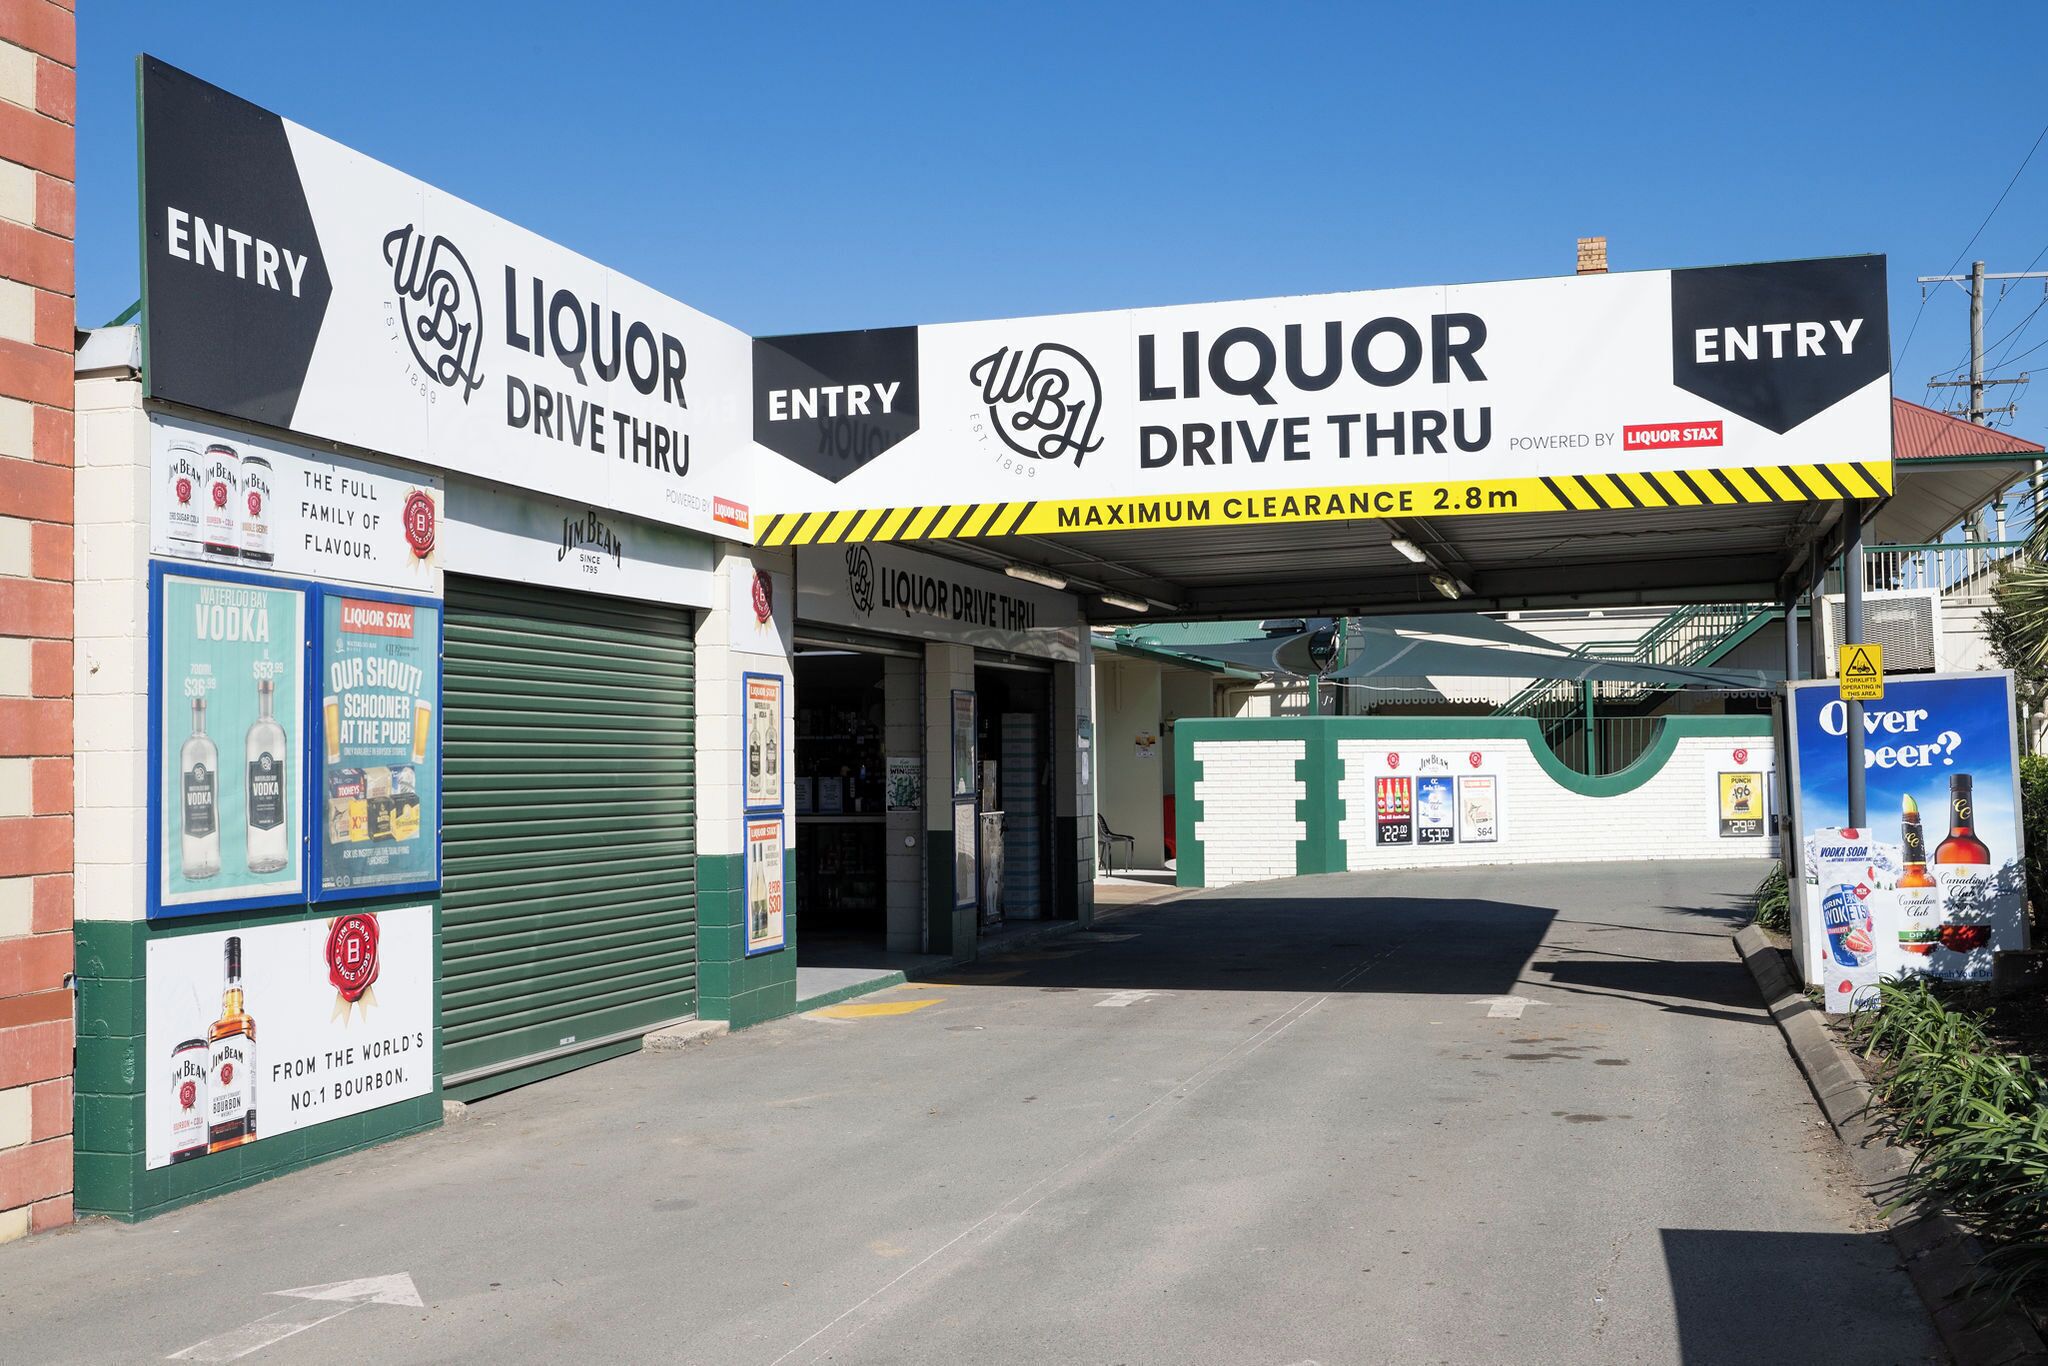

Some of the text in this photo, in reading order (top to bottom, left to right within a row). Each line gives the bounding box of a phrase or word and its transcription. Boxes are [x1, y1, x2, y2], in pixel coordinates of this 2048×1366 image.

[167, 206, 307, 298] ENTRY
[504, 264, 688, 409] LIQUOR
[1696, 318, 1863, 363] ENTRY
[1138, 312, 1488, 405] LIQUOR
[768, 381, 901, 421] ENTRY
[506, 374, 690, 478] DRIVE THRU
[1140, 406, 1492, 470] DRIVE THRU
[1509, 425, 1719, 452] POWERED BY LIQUOR STAX
[180, 459, 202, 488] BEAM
[216, 462, 237, 492] BEAM
[996, 453, 1035, 478] 1889
[304, 470, 377, 501] THE FULL
[301, 502, 380, 531] FAMILY OF
[666, 489, 701, 511] POWERED
[715, 503, 734, 519] LIQUOR
[735, 509, 748, 523] STAX
[1058, 486, 1518, 528] MAXIMUM CLEARANCE 2.8m
[305, 534, 377, 561] FLAVOUR.
[558, 511, 621, 568] JIM BEAM
[580, 553, 600, 565] SINCE
[583, 565, 598, 574] 1795
[200, 587, 268, 609] WATERLOO BAY
[881, 567, 1035, 632] LIQUOR DRIVE THRU
[195, 604, 269, 643] VODKA
[344, 607, 411, 629] LIQUOR STAX
[331, 656, 423, 697] OUR SHOUT!
[344, 693, 410, 719] SCHOONER
[1819, 700, 1928, 736] Over
[340, 720, 410, 745] AT THE PUB!
[187, 792, 212, 806] VODKA
[253, 782, 279, 796] VODKA
[1477, 827, 1492, 837] $64
[1820, 846, 1868, 858] VODKA SODA
[1940, 869, 1987, 885] Canadian
[769, 895, 781, 915] $30
[1897, 894, 1937, 906] Canadian
[1947, 885, 1976, 898] Club
[1904, 905, 1929, 917] Club
[336, 920, 370, 945] JIM BEAM
[347, 938, 360, 963] B
[335, 953, 370, 981] SINCE 1795
[211, 1046, 244, 1072] JIM BEAM
[272, 1032, 423, 1082] FROM THE WORLD'S
[184, 1060, 207, 1085] BEAM
[290, 1068, 409, 1111] NO.1 BOURBON.
[213, 1096, 241, 1114] BOURBON
